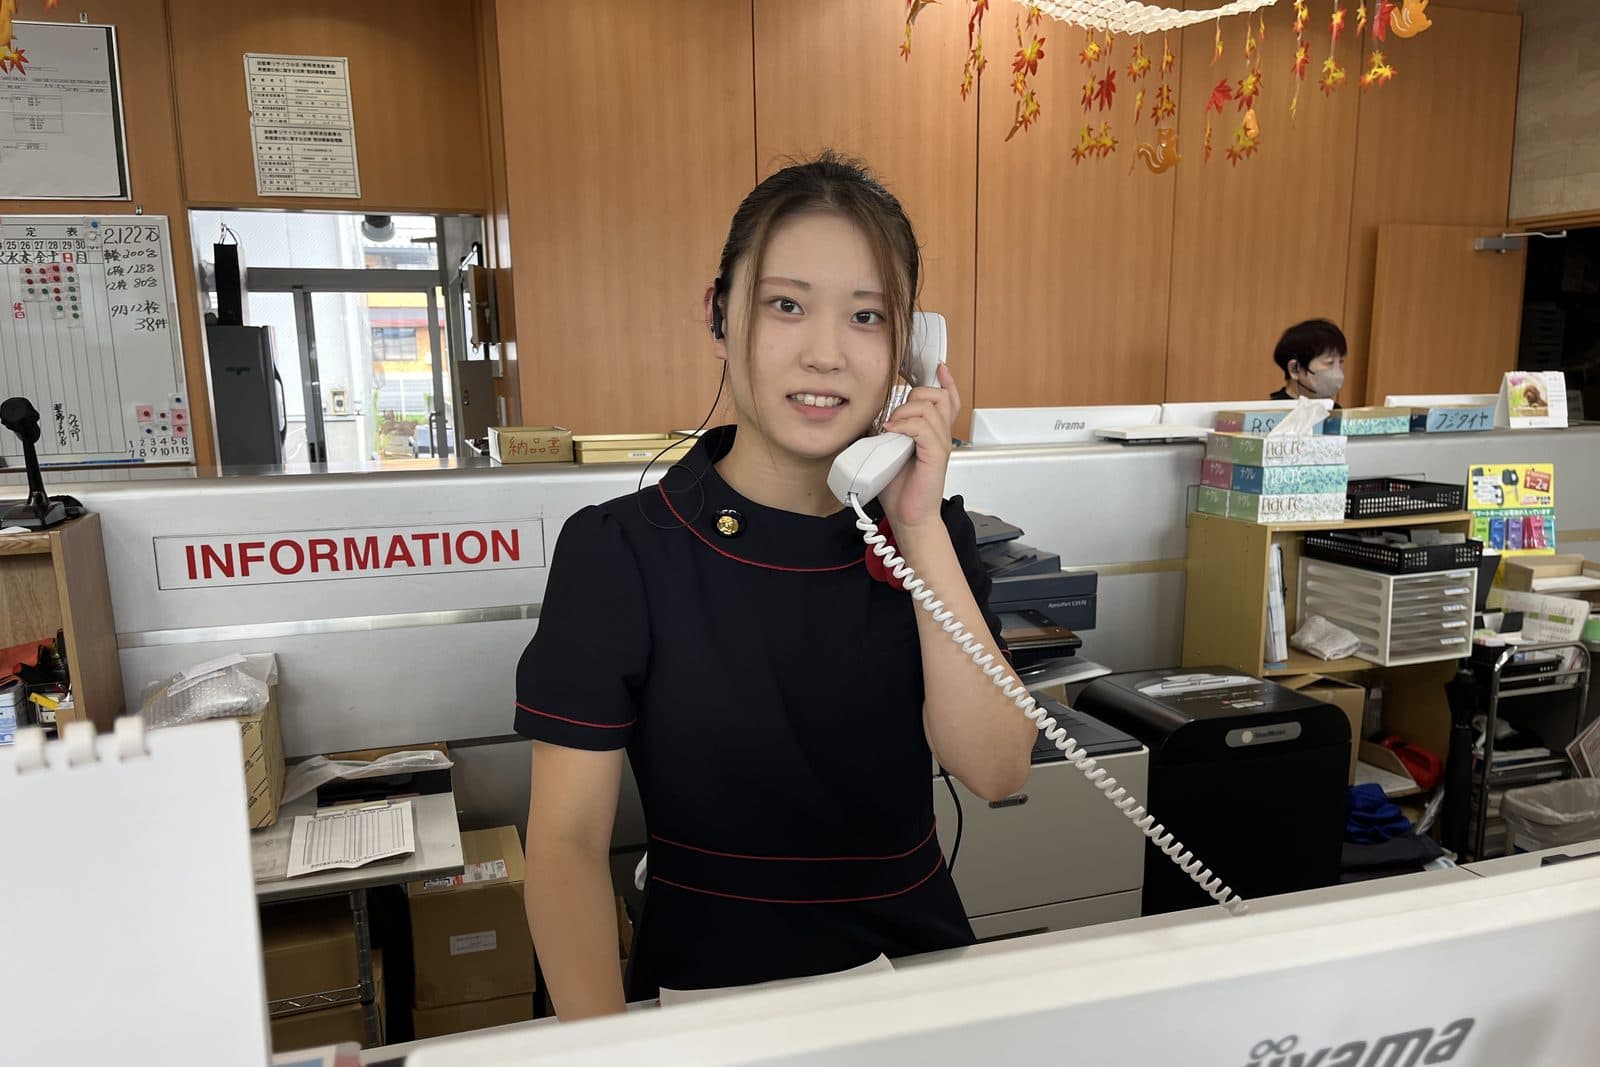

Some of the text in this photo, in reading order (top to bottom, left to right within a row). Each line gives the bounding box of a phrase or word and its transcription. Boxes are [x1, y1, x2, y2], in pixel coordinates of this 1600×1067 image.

[26, 227, 78, 237] 定 表
[7, 241, 86, 250] 25 26 27 28 29 30
[63, 252, 73, 263] 日
[1054, 418, 1086, 431] iiyama
[1435, 411, 1489, 430] フジタイヤ
[160, 447, 169, 456] 10
[181, 446, 189, 455] 12
[508, 436, 560, 457] 納品書
[185, 529, 520, 579] INFORMATION
